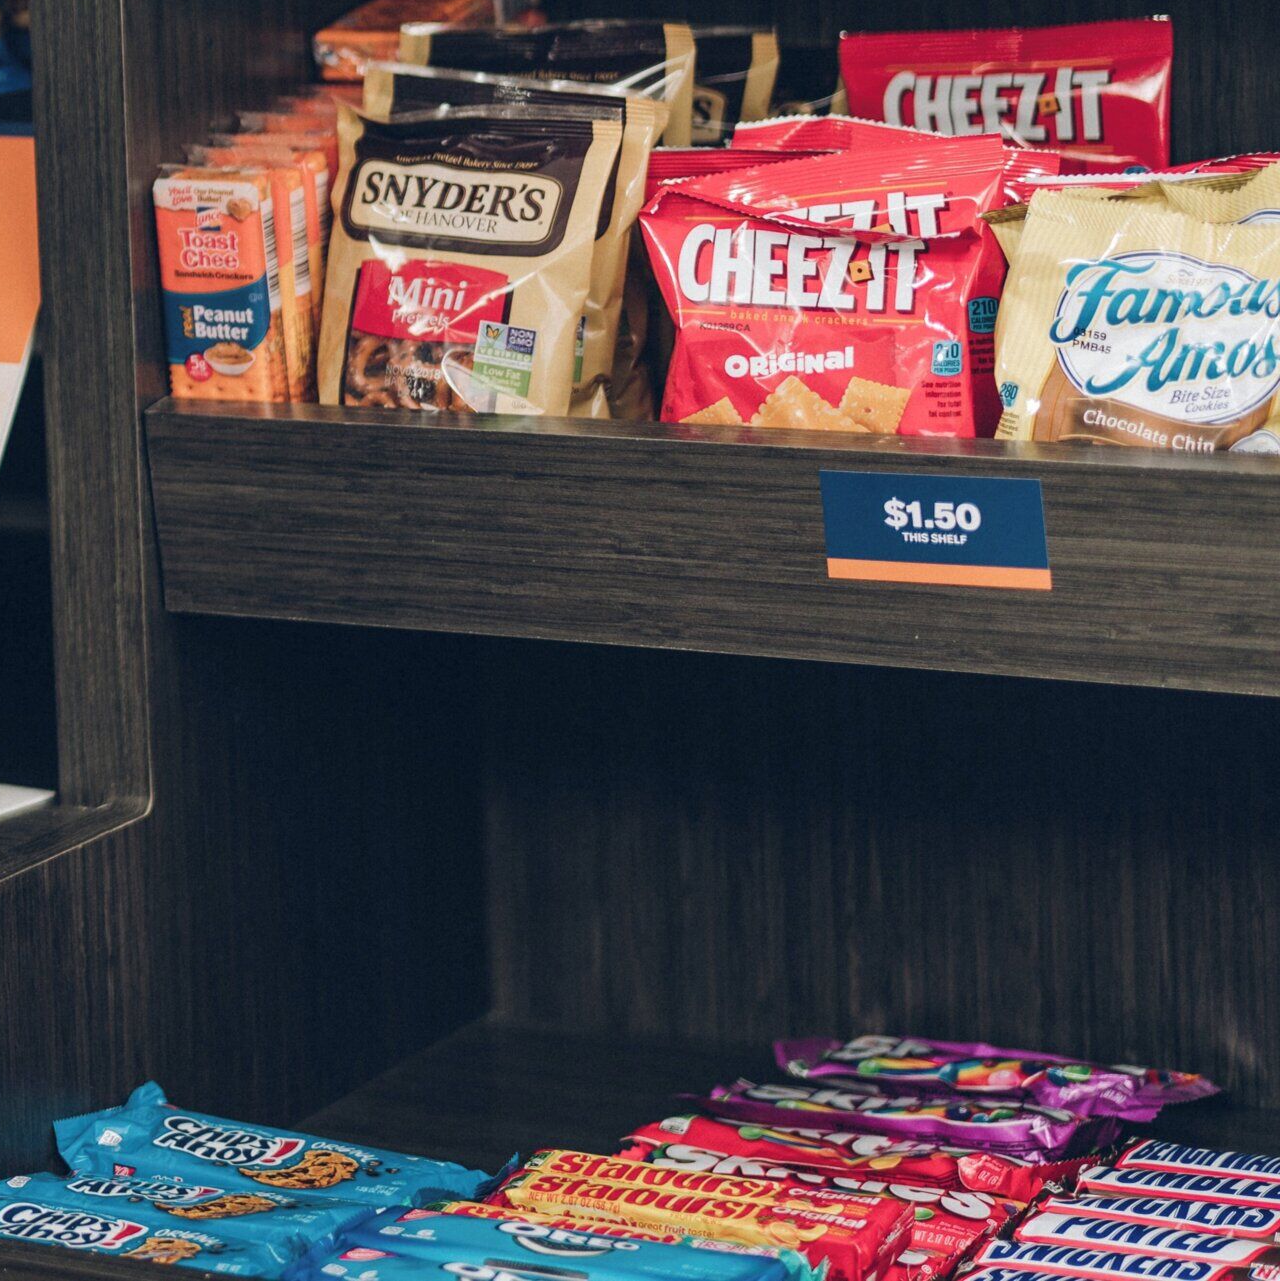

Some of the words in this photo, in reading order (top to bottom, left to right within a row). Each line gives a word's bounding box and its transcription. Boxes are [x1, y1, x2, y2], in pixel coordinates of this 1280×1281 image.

[433, 152, 462, 166] Pretzel
[463, 155, 490, 169] Bakery
[492, 159, 513, 170] Since
[361, 171, 546, 223] SNYDER'S
[415, 210, 497, 234] HANOVER
[179, 229, 238, 251] Toast
[181, 249, 239, 269] Chee
[175, 270, 215, 279] Sandwich
[215, 272, 253, 281] Crackers
[387, 276, 468, 312] Mini
[193, 304, 254, 324] Peanut
[972, 300, 996, 315] 210
[730, 310, 768, 322] baked
[815, 314, 868, 326] crackers
[194, 322, 249, 341] Butter
[510, 329, 535, 339] NON
[509, 337, 533, 347] GMO
[936, 343, 959, 359] 210
[1086, 327, 1280, 393] Amos
[1000, 383, 1019, 400] 280
[1169, 388, 1200, 405] Bite
[1201, 385, 1231, 400] Size
[1184, 400, 1230, 413] Cookies
[1083, 409, 1167, 445] Chocolate
[883, 496, 982, 532] $1.50
[902, 531, 929, 544] THIS
[931, 532, 968, 546] SHELF
[164, 1116, 272, 1152] Chips
[528, 1191, 544, 1201] NET
[788, 1188, 882, 1206] Original
[772, 1206, 868, 1229] Original
[496, 1221, 640, 1251] OREO
[664, 1224, 686, 1235] fruit
